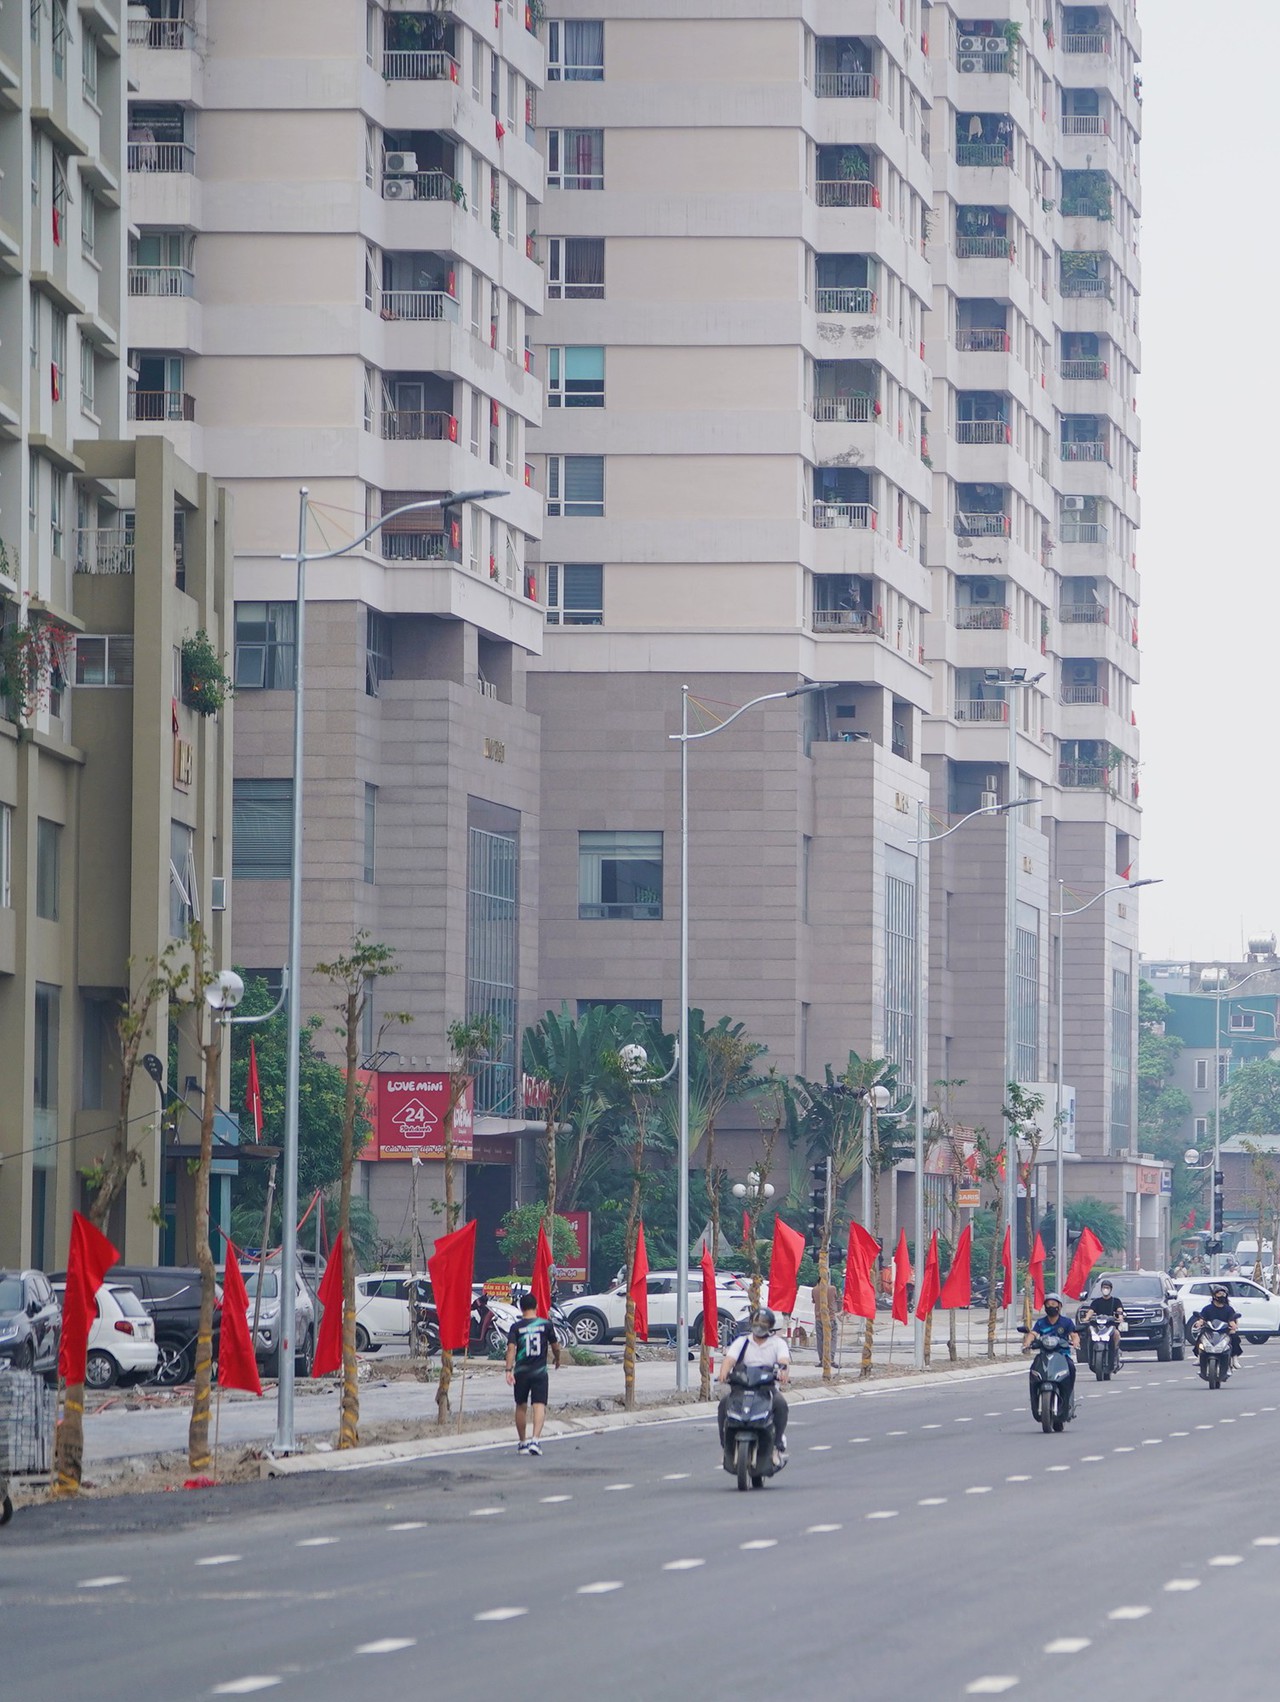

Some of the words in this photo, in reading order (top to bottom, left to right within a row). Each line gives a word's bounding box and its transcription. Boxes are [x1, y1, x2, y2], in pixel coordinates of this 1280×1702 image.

[388, 1081, 415, 1092] LOVE
[405, 1108, 425, 1122] 24
[524, 1333, 541, 1356] 13
